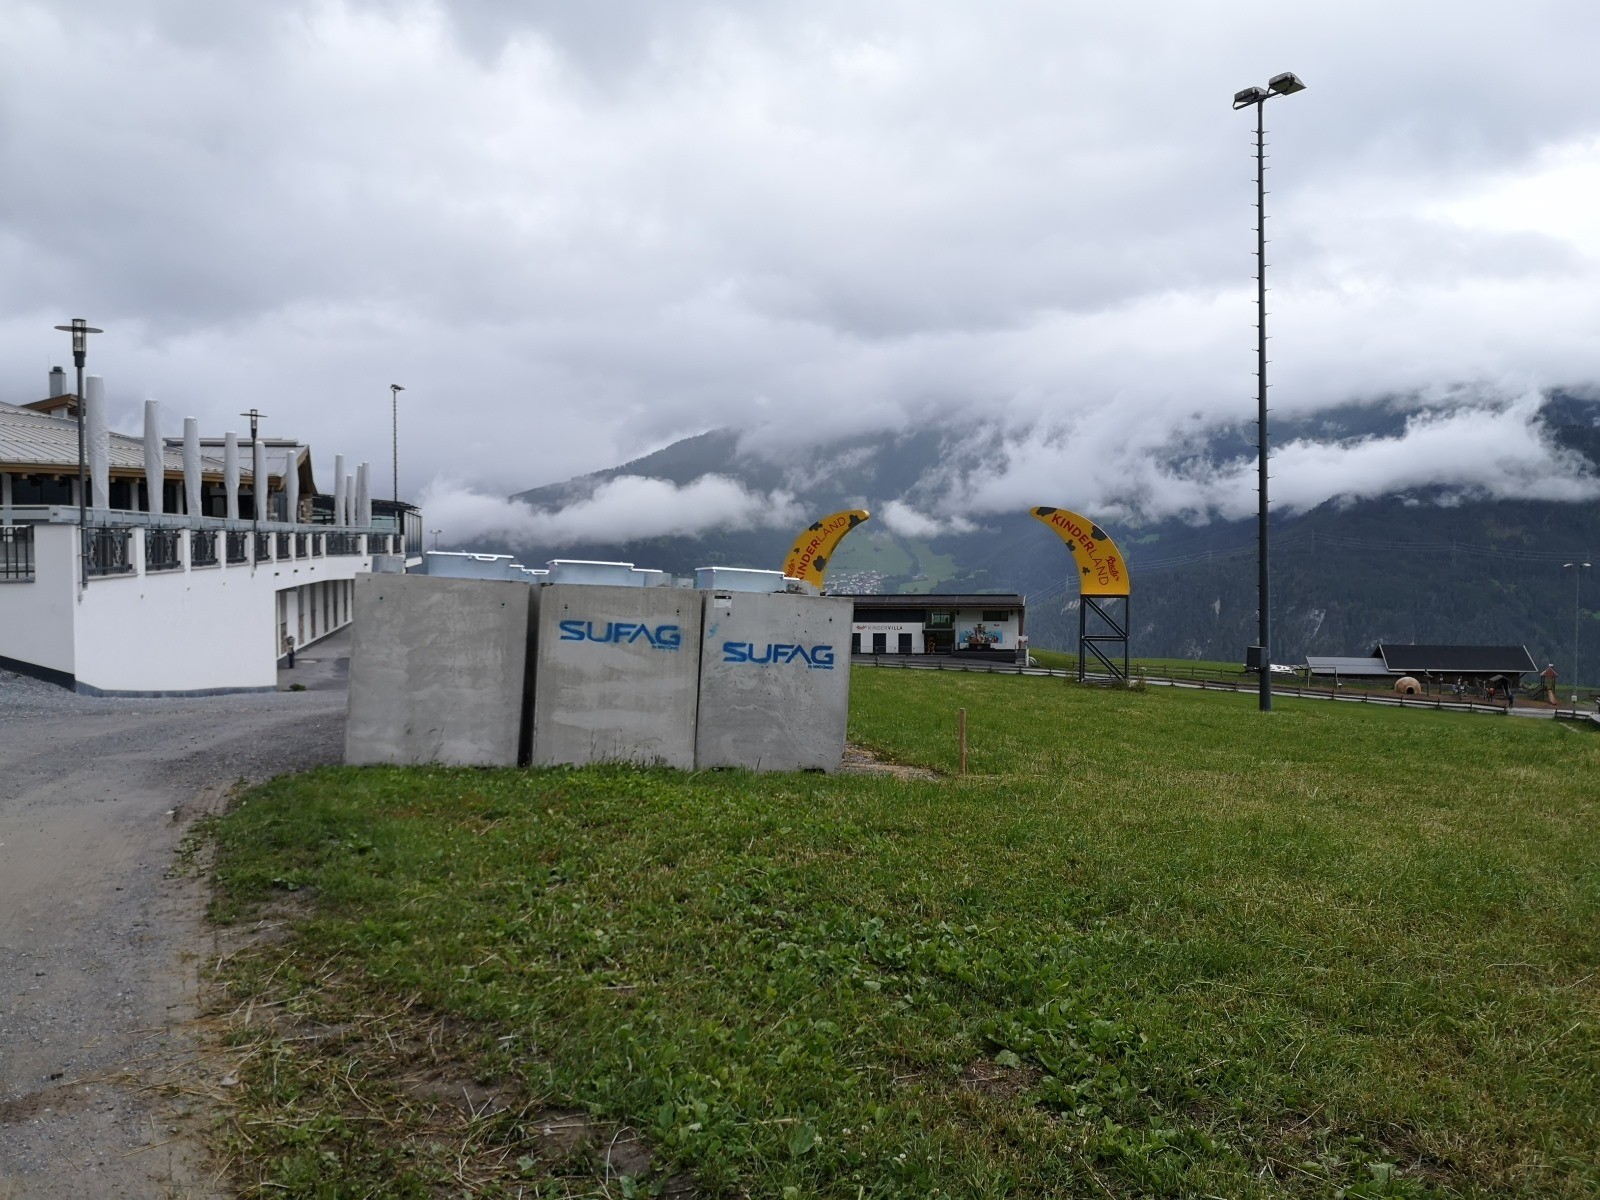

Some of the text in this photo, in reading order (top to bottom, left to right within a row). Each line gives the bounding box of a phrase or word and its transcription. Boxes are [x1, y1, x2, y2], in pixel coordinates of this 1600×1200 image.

[1051, 513, 1109, 586] KINDERLAND
[559, 620, 681, 646] SUFAG
[722, 641, 834, 665] SUFAG
